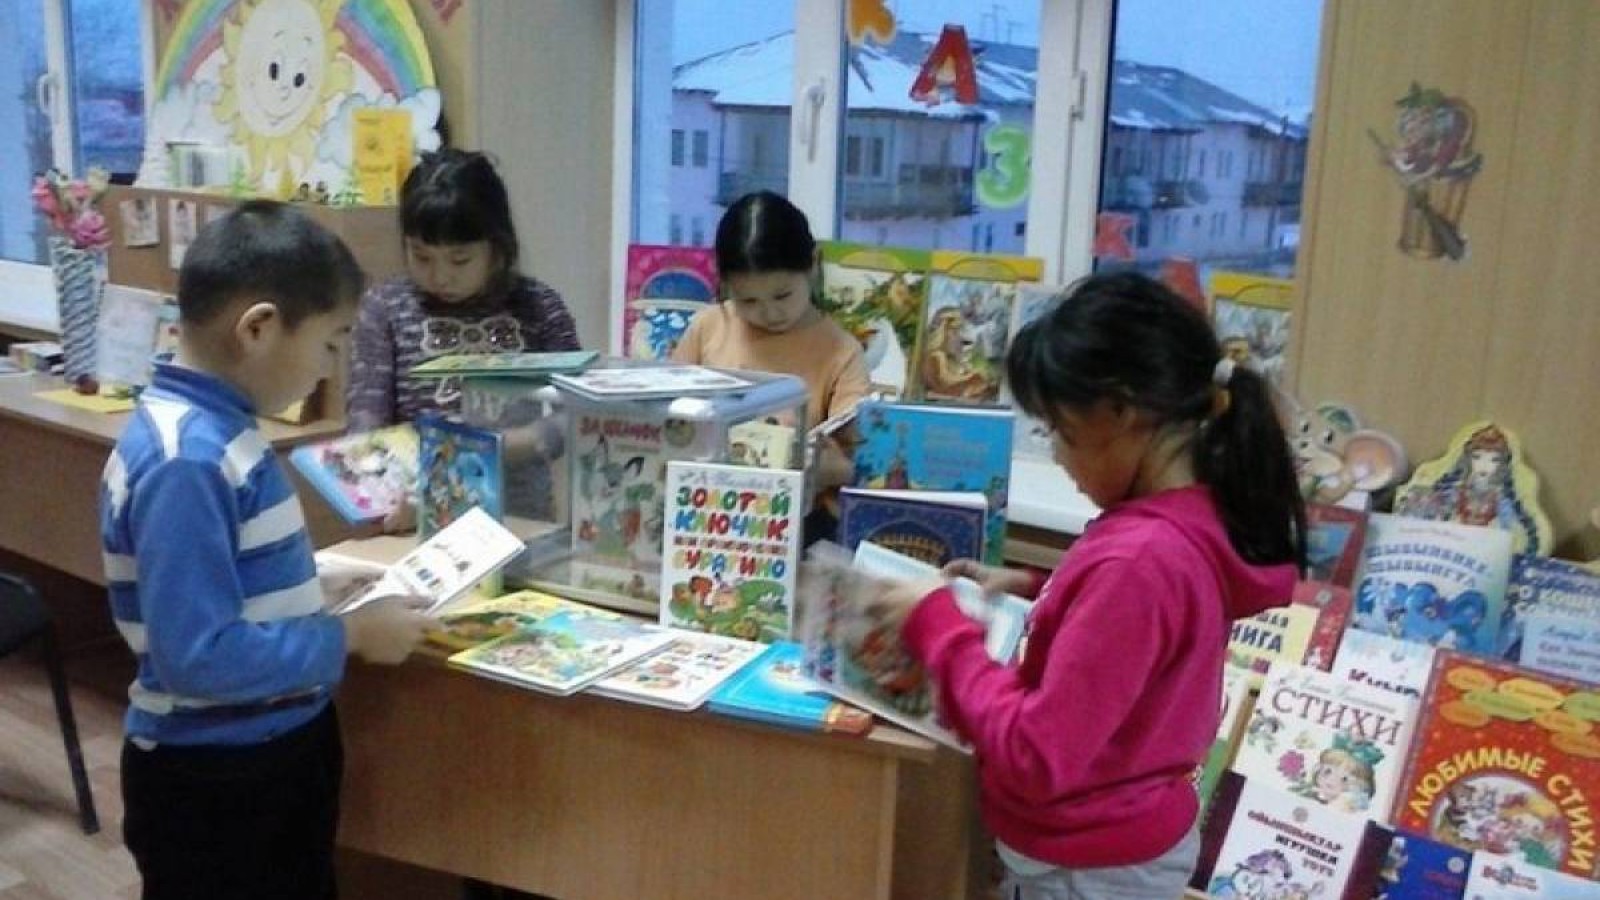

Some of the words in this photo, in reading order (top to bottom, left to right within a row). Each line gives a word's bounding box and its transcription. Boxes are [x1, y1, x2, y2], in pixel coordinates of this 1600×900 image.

[675, 486, 791, 516] ЗОЛОТОЙ
[672, 549, 786, 578] БУРАТИНО
[1231, 623, 1283, 653] НИГА
[1271, 686, 1403, 746] СТИХИ
[1408, 746, 1548, 818] ЛЮБИМЫЕ
[1547, 773, 1597, 870] СТИХИ
